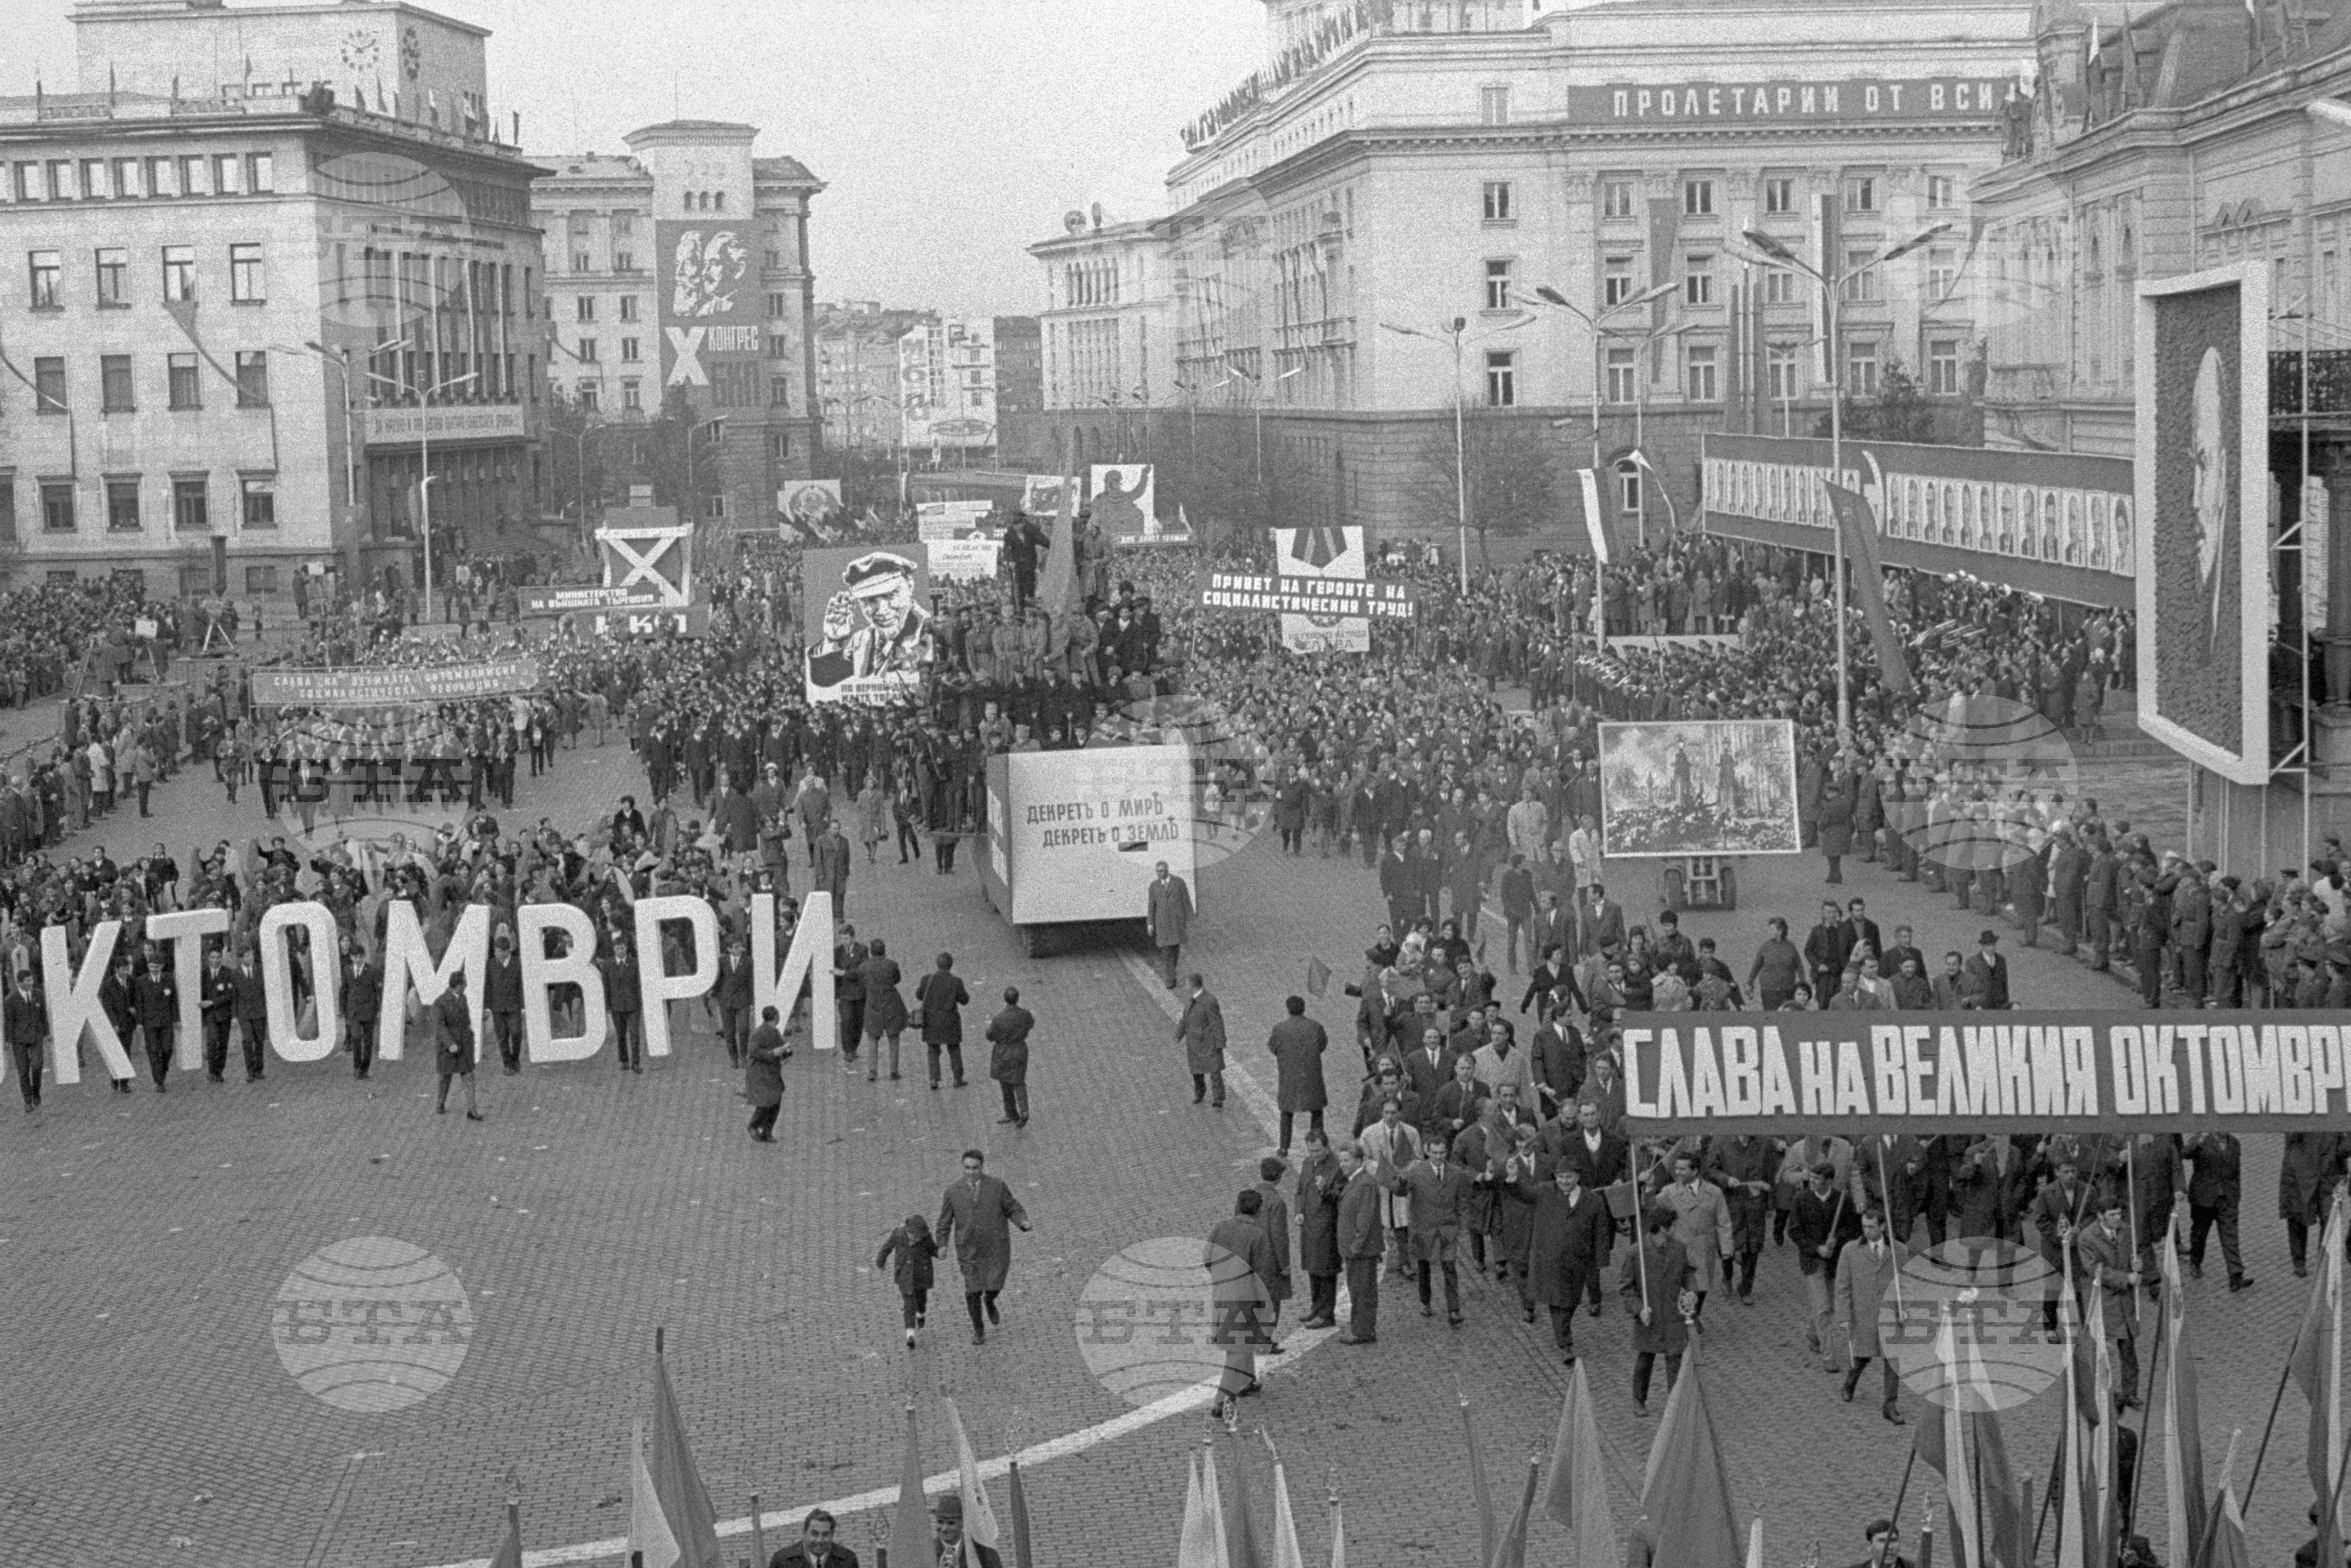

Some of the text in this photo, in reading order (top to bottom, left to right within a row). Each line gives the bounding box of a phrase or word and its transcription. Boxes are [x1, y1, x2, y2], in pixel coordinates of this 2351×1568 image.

[1613, 85, 1839, 117] ПРОЛЕТАРИИ
[1865, 84, 1903, 112] ОТ
[707, 325, 759, 351] КОНГРЕС
[711, 360, 761, 407] БКП
[555, 588, 627, 599] МИНИСТЕРСТВО
[1212, 574, 1406, 599] ПРИВЕТ НА ГЕРОИТЕ НА
[531, 599, 544, 609] НА
[1203, 591, 1414, 618] СОЦИАЛИСТИЧЕСКИЯ ТРУД!
[274, 676, 312, 686] СЛАВА
[324, 676, 339, 686] НА
[1026, 802, 1094, 825] ДЕКРЕТЪ
[1101, 800, 1110, 819] О
[1043, 827, 1106, 848] ДЕКРЕТЪ
[1111, 826, 1120, 842] О
[0, 890, 836, 1085] КТОМВРИ
[1623, 1025, 1796, 1118] СЛАВА
[1798, 1040, 1871, 1116] НА
[1870, 1025, 2099, 1116] ВЕЛИКИЯ
